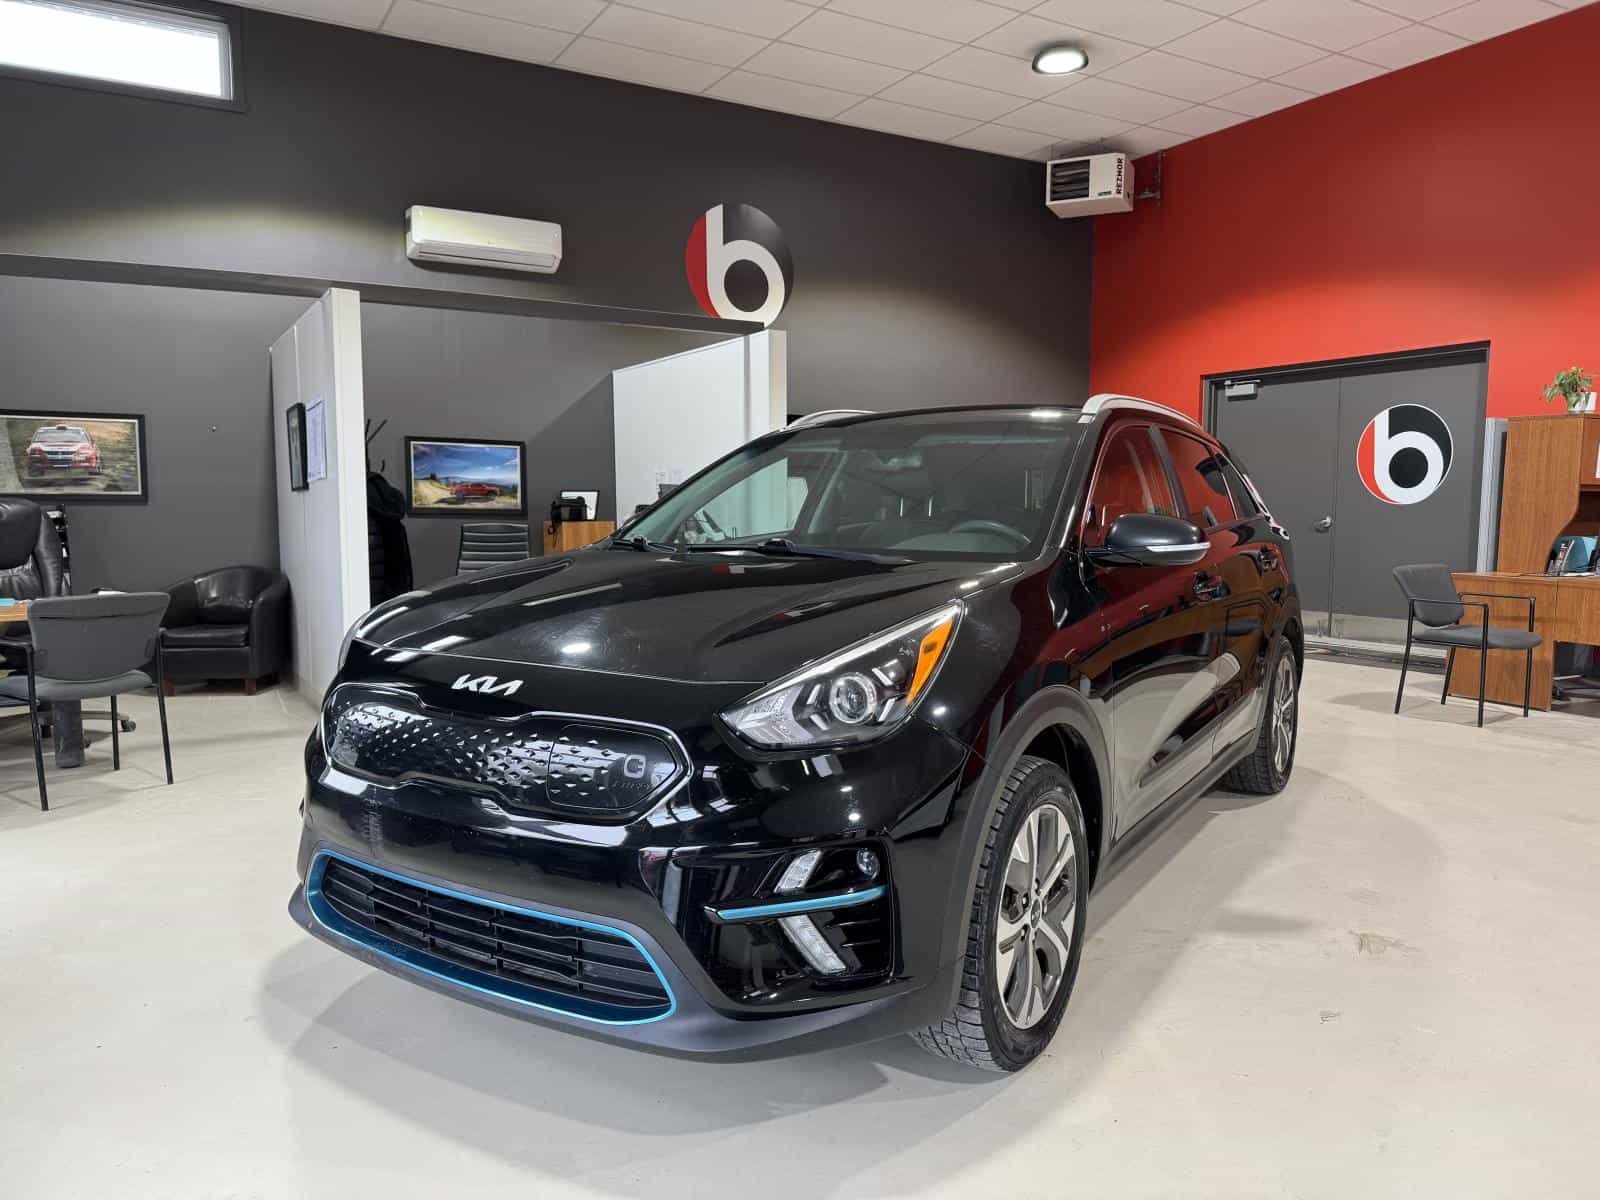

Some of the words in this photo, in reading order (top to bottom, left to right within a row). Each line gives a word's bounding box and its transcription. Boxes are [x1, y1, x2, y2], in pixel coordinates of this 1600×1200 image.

[705, 203, 786, 328] b
[1374, 408, 1444, 505] b
[451, 674, 524, 696] KIA
